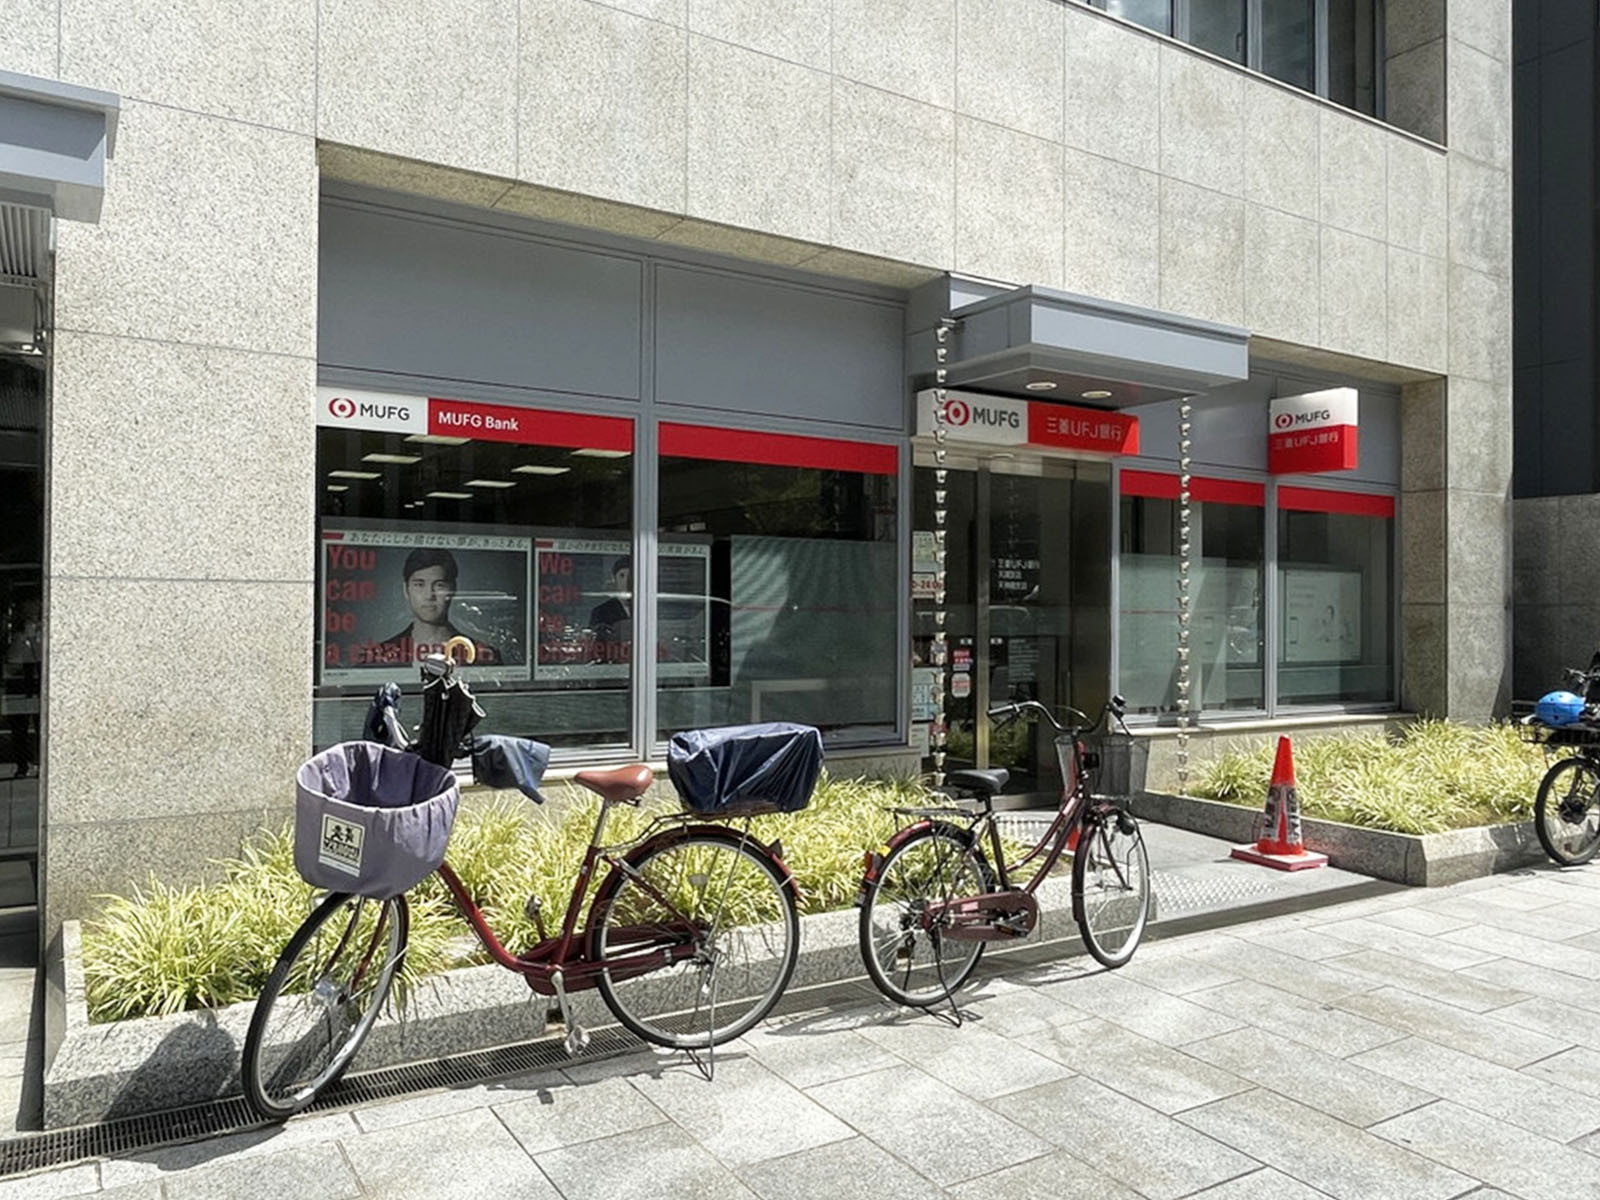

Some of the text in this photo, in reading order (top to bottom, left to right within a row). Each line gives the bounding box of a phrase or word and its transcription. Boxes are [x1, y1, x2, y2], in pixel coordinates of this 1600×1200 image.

[360, 403, 410, 421] MUFG
[438, 411, 519, 431] MUFG Bank
[973, 406, 1020, 428] MUFG
[1295, 410, 1330, 425] MUFG
[1046, 416, 1122, 441] 三菱UFJ銀行
[328, 545, 376, 570] You
[540, 552, 573, 576] We
[327, 580, 376, 602] can
[325, 608, 356, 633] be
[325, 643, 340, 664] a
